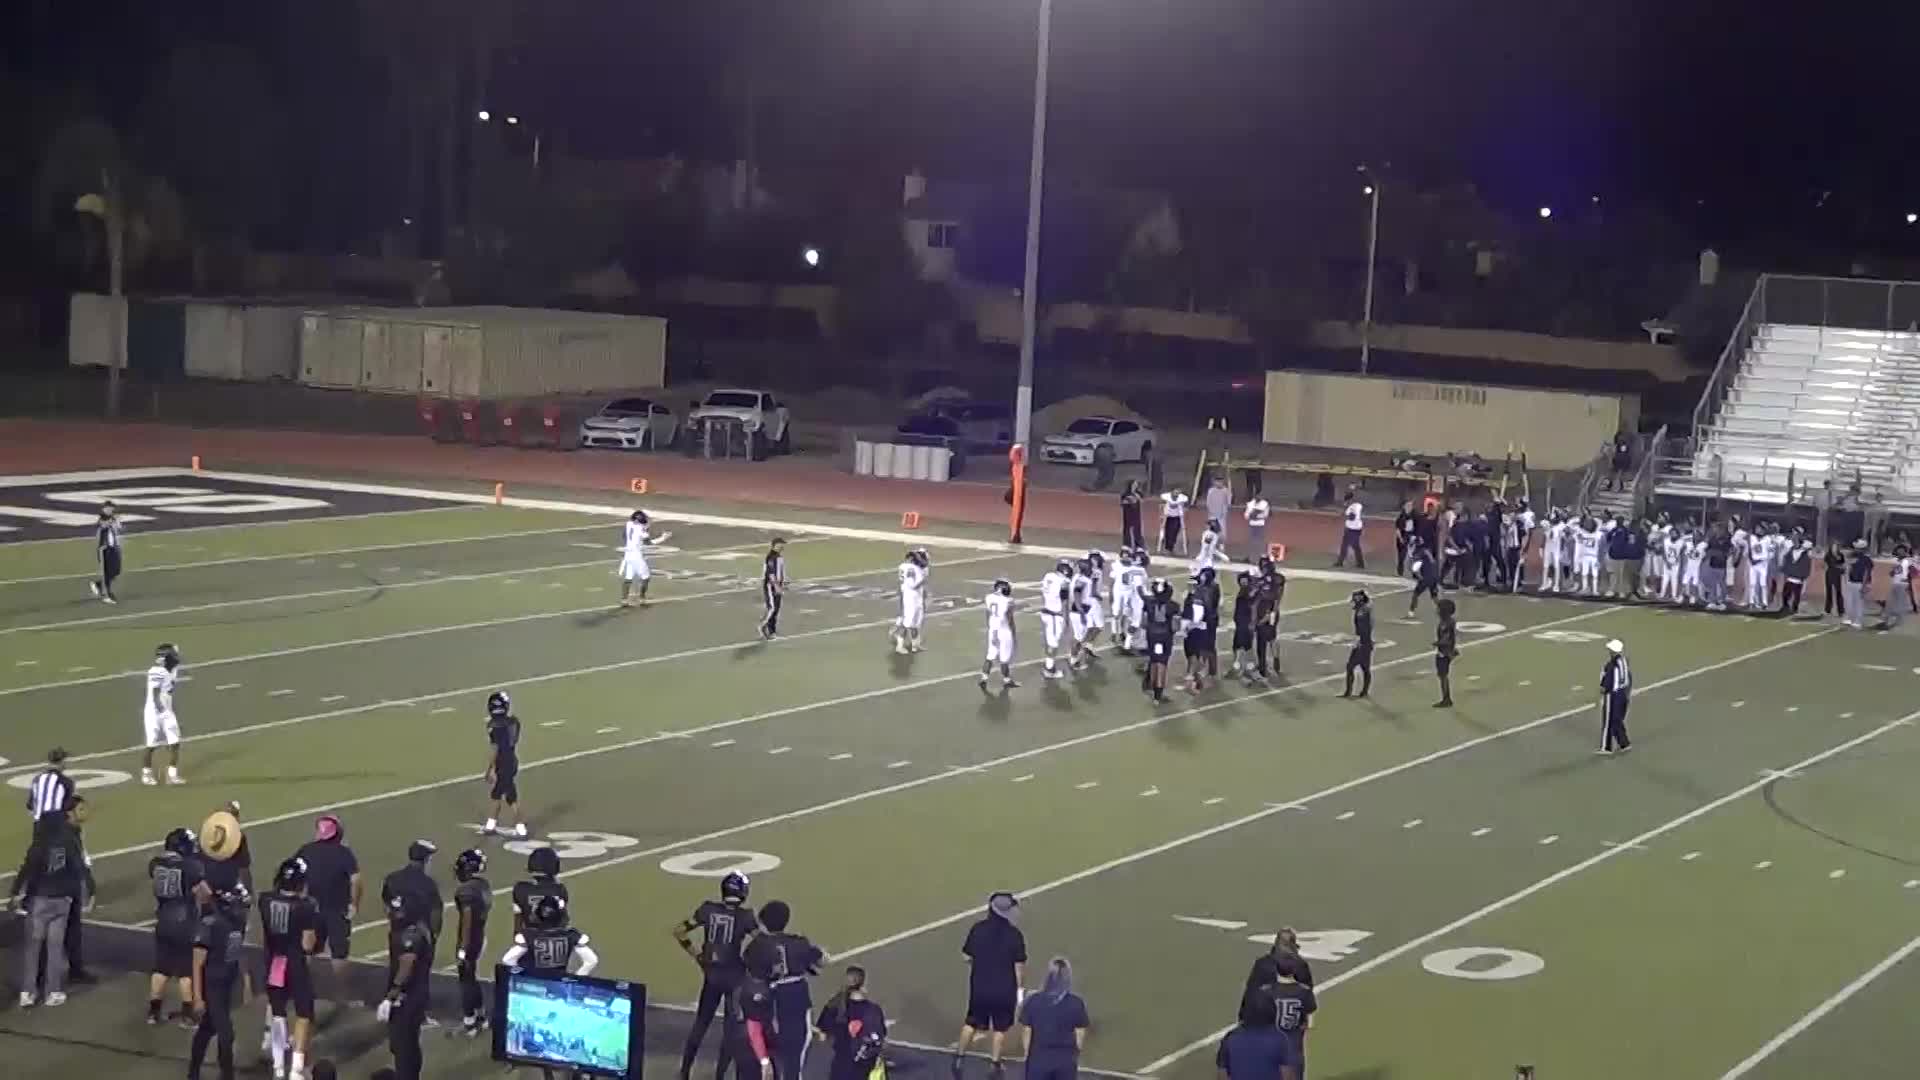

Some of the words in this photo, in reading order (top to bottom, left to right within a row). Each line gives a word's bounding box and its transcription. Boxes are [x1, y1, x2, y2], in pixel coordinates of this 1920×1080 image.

[708, 912, 735, 943] 17
[533, 935, 569, 968] 20
[1275, 998, 1302, 1031] 15
